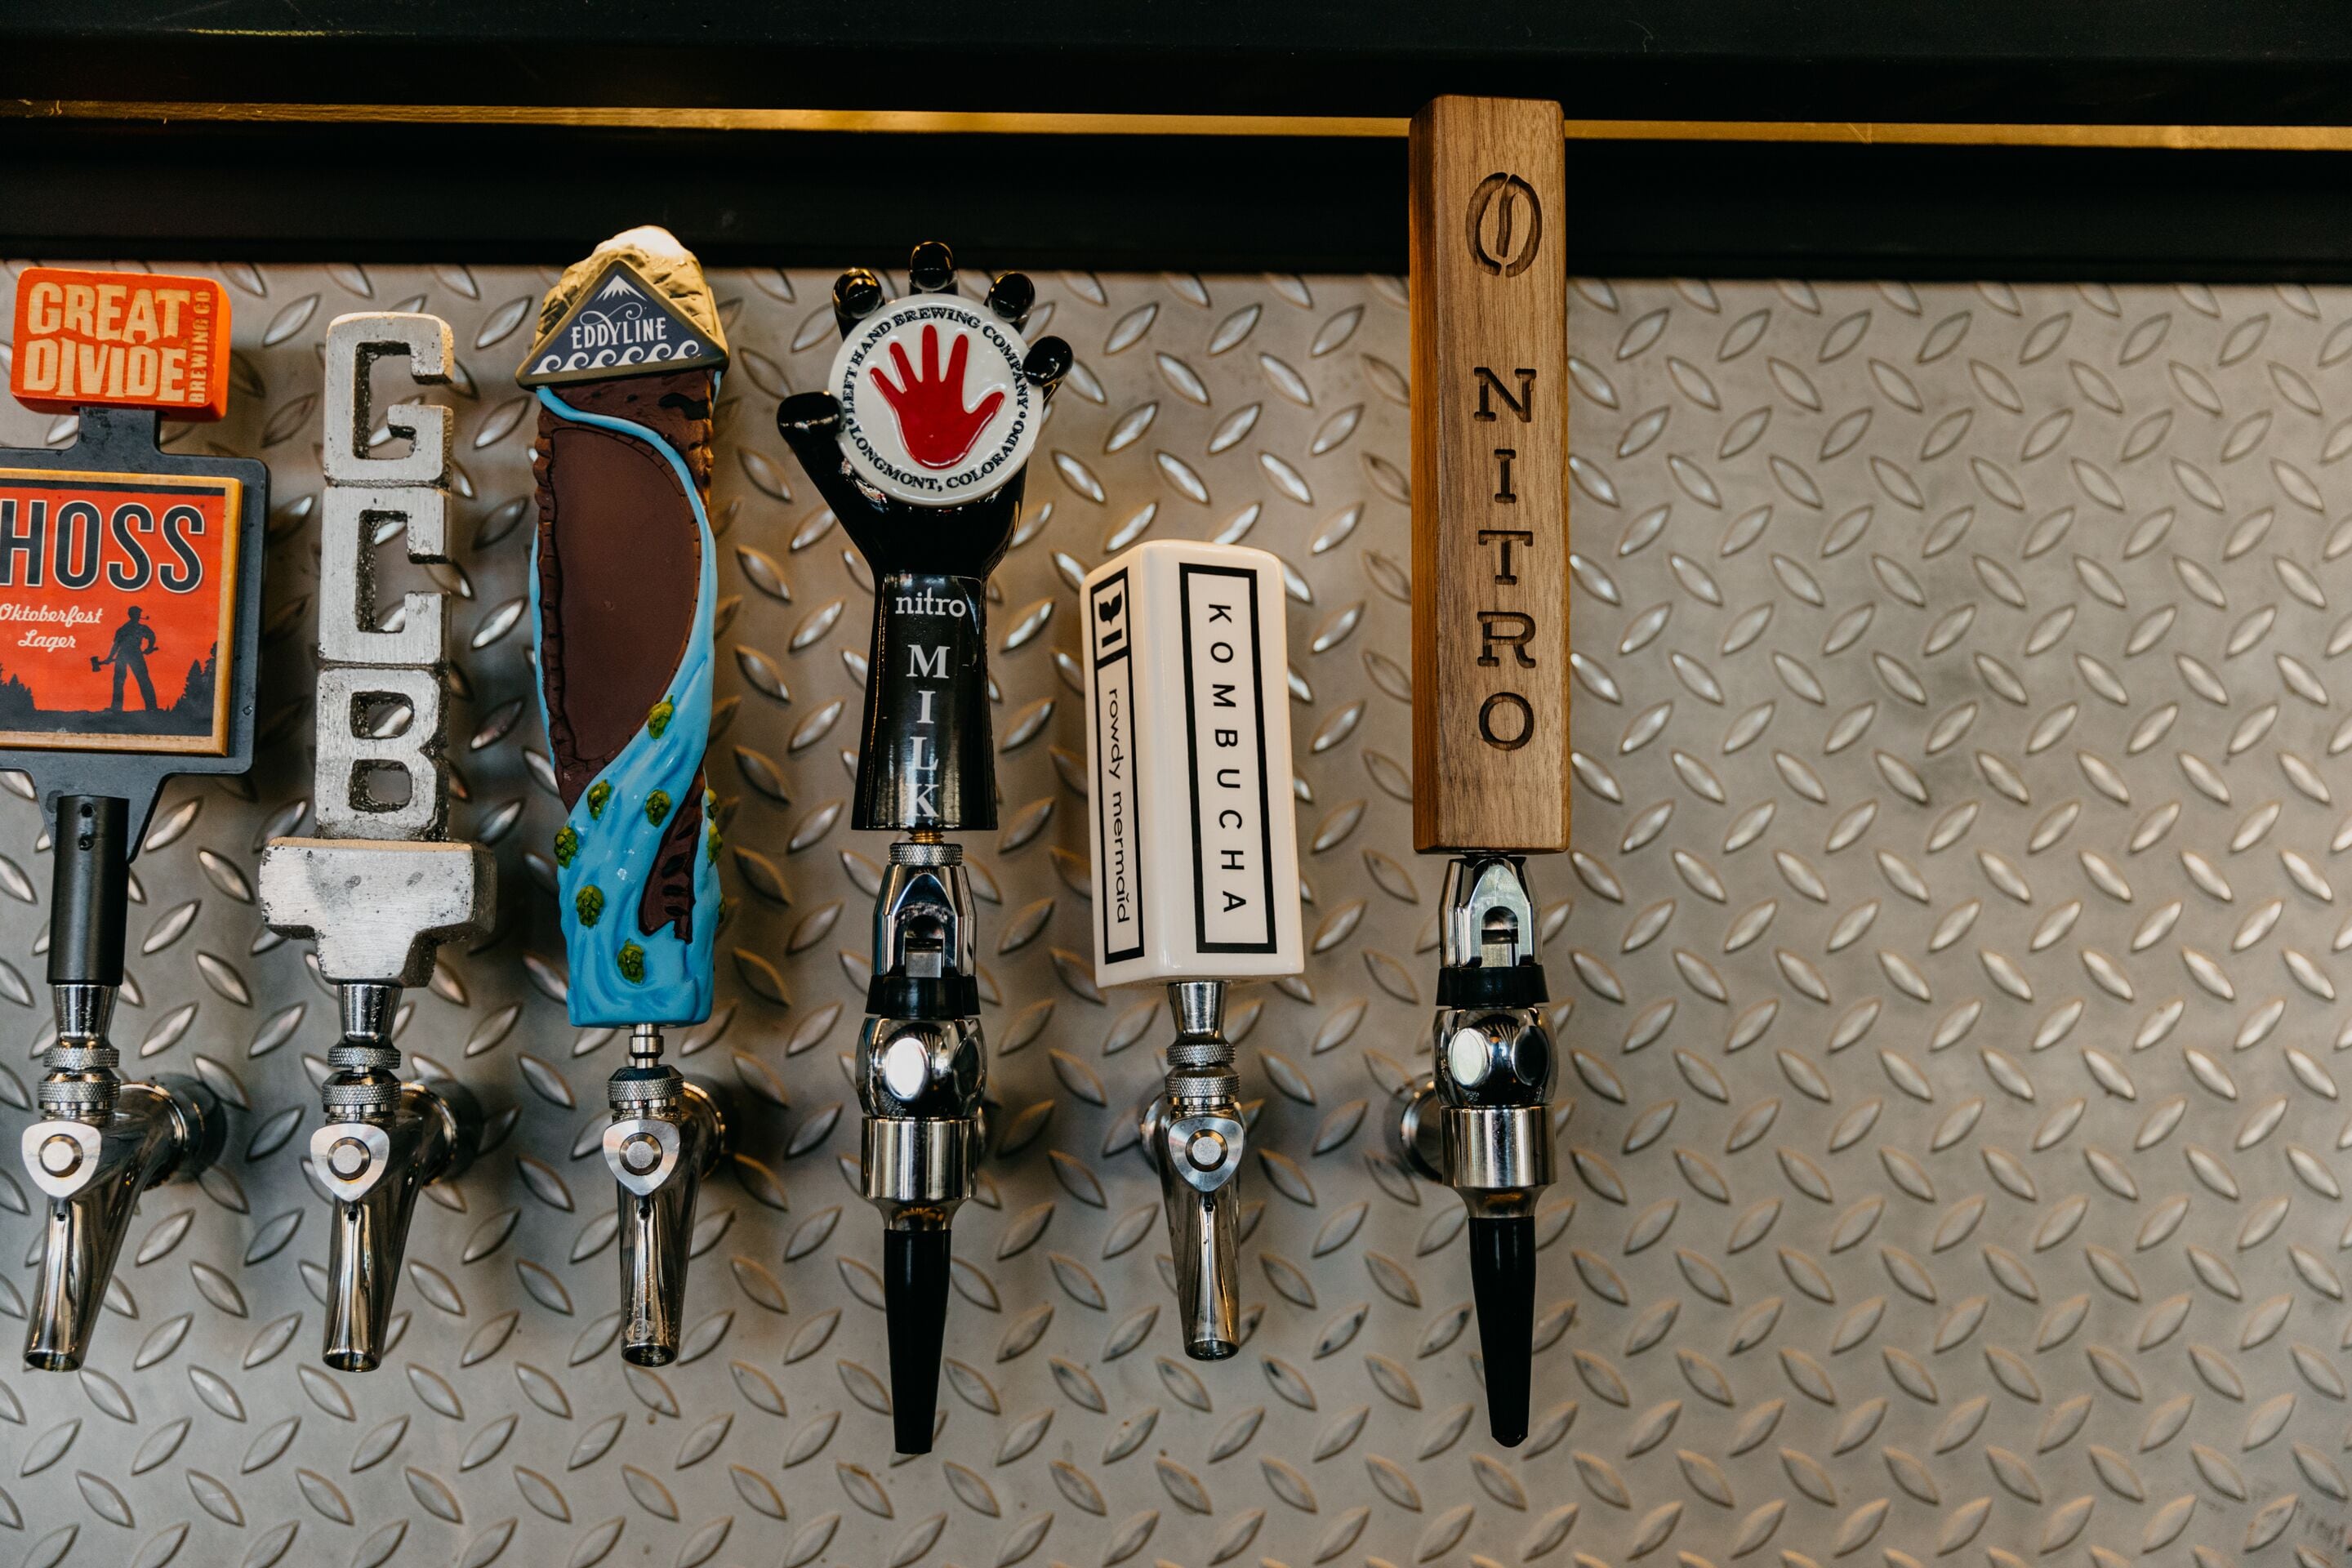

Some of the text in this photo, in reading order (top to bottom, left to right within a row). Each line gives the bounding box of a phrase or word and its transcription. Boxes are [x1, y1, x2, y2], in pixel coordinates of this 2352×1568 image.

[27, 282, 191, 345] GREAT
[189, 291, 212, 403] BREWING CO
[570, 314, 667, 350] EDDYLINE
[843, 307, 1029, 414] LEFT HAND BREWING COMPANY
[23, 337, 188, 403] DIVIDE
[849, 420, 1026, 492] LONGMONT, COLORADO
[0, 498, 204, 594] HOSS
[315, 311, 454, 840] GCCB
[1473, 366, 1538, 751] NITRO
[0, 603, 103, 627] Oktoberfest
[17, 629, 77, 653] Lager
[895, 586, 967, 617] nitro
[905, 644, 951, 817] MILK
[1208, 603, 1247, 913] KOMBUCHA
[1108, 688, 1130, 924] rowdy mermaid
